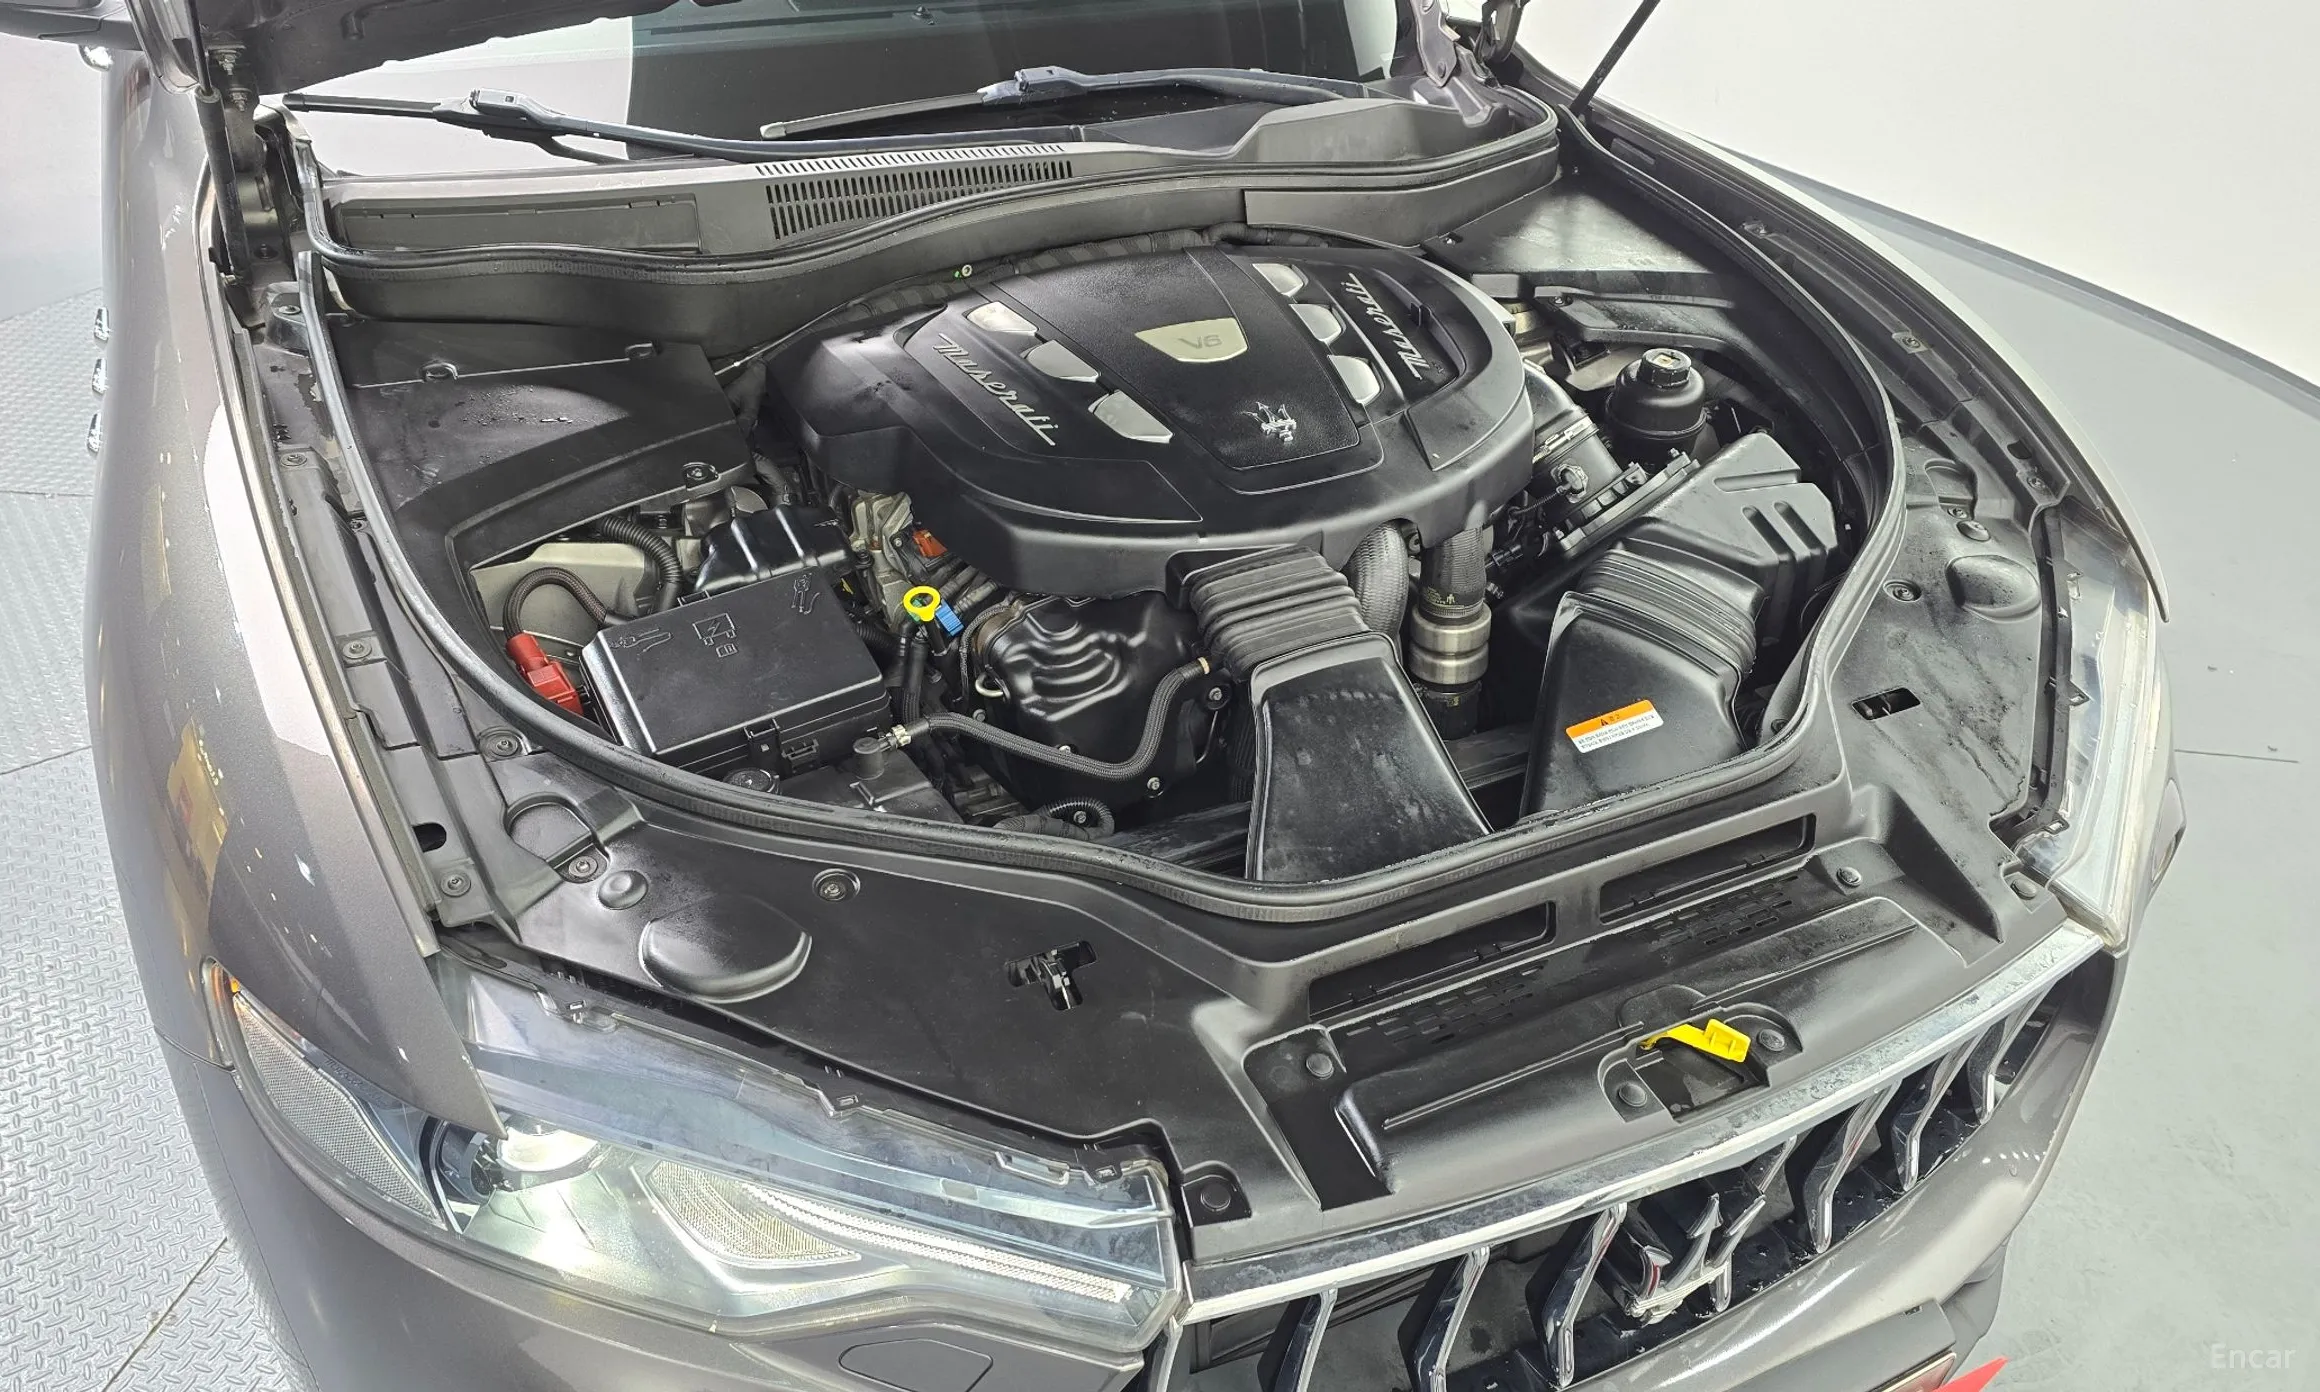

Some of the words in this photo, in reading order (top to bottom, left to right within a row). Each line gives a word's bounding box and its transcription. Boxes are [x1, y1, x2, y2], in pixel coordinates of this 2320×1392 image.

[1177, 334, 1222, 349] V6
[1340, 272, 1430, 380] Maserati
[932, 332, 1059, 446] Maserati
